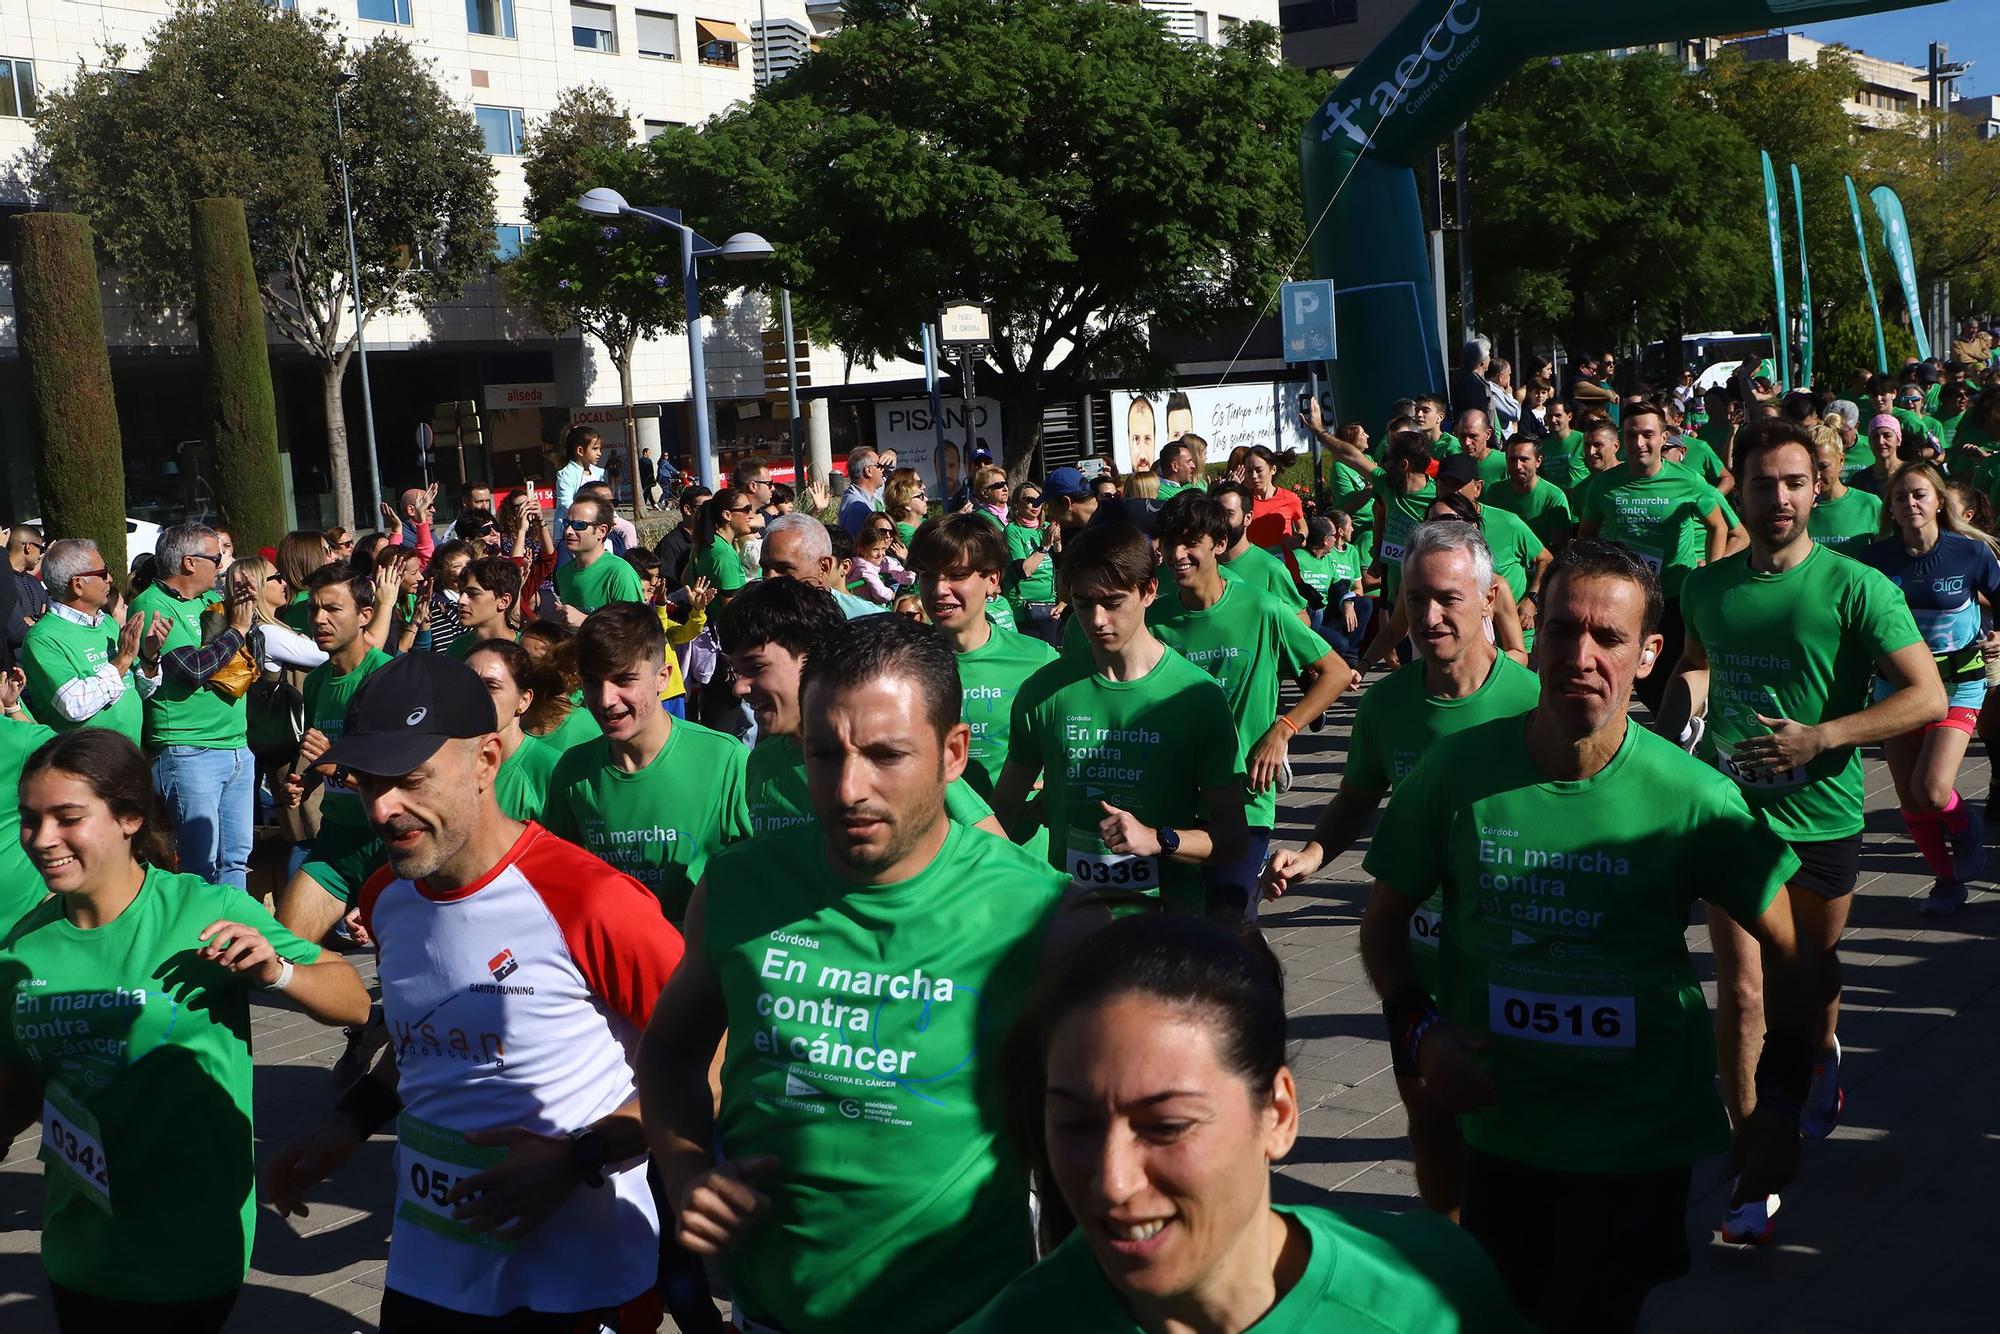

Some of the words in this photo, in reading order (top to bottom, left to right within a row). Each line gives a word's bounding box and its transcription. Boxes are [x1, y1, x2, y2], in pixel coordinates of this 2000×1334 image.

[1369, 0, 1480, 117] aecc
[1405, 80, 1439, 115] Contra
[1437, 68, 1449, 83] el
[1447, 35, 1481, 72] Cáncer
[1294, 291, 1320, 325] P
[507, 388, 543, 402] aliseda
[574, 411, 605, 424] LOCAL
[1212, 403, 1226, 427] Es
[1255, 396, 1264, 415] de
[1615, 497, 1628, 505] En
[1632, 497, 1669, 505] marcha
[1616, 507, 1648, 515] contra
[1185, 646, 1238, 662] marcha
[1725, 653, 1791, 670] marcha
[961, 685, 1002, 699] rcha
[1066, 724, 1089, 740] En
[1096, 727, 1160, 744] marcha
[1066, 745, 1121, 760] contra
[1066, 762, 1081, 779] el
[1086, 762, 1143, 781] cáncer
[610, 825, 677, 844] marcha
[1481, 826, 1519, 838] Córdoba
[1479, 839, 1512, 865] En
[1524, 849, 1630, 876] marcha
[1076, 860, 1150, 883] 0336
[1478, 872, 1565, 897] contra
[1480, 896, 1501, 914] el
[1509, 899, 1606, 928] cáncer
[770, 930, 820, 949] Córdoba
[761, 948, 807, 983] En
[818, 969, 954, 1001] marcha
[469, 983, 496, 994] GARITO
[497, 985, 534, 996] RUNNING
[16, 992, 40, 1014] En
[50, 986, 147, 1012] marcha
[757, 993, 870, 1032] contra
[1504, 998, 1621, 1038] 0516
[16, 1017, 91, 1040] contra
[754, 1026, 779, 1054] el
[790, 1033, 917, 1074] cáncer
[823, 1073, 853, 1085] CONTRA
[865, 1078, 897, 1088] CÁNCER
